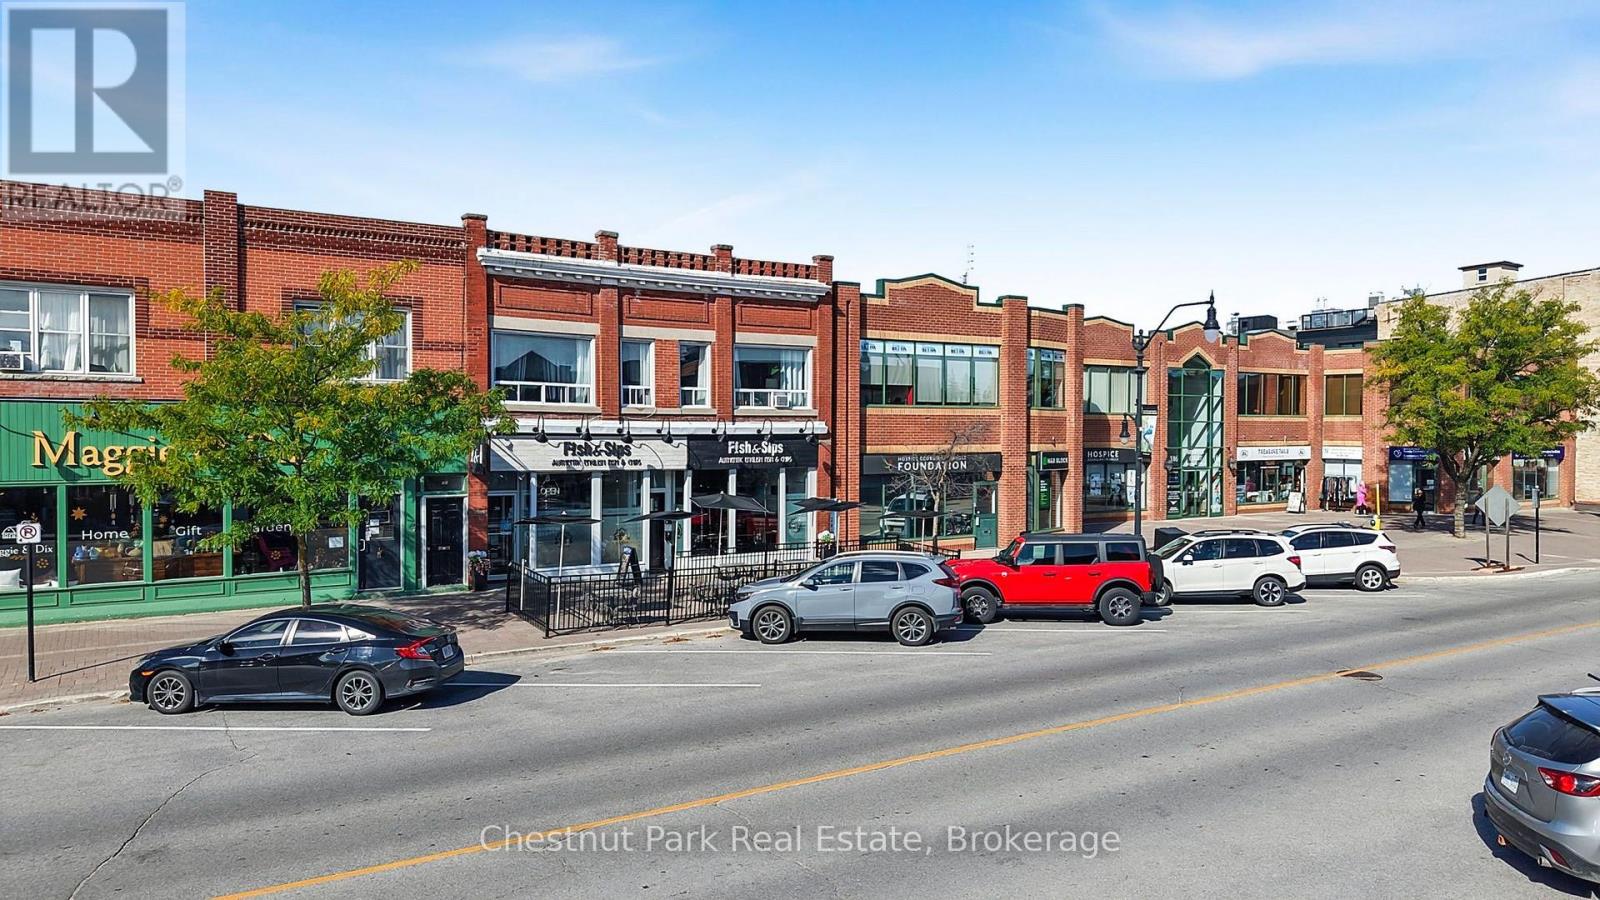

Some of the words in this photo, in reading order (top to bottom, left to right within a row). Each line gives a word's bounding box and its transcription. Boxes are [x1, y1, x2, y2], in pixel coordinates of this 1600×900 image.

[1087, 450, 1119, 458] HOSPICE
[897, 461, 967, 471] FOUNDATION
[82, 530, 129, 540] Home
[175, 525, 202, 536] Gift
[35, 544, 53, 553] Dix
